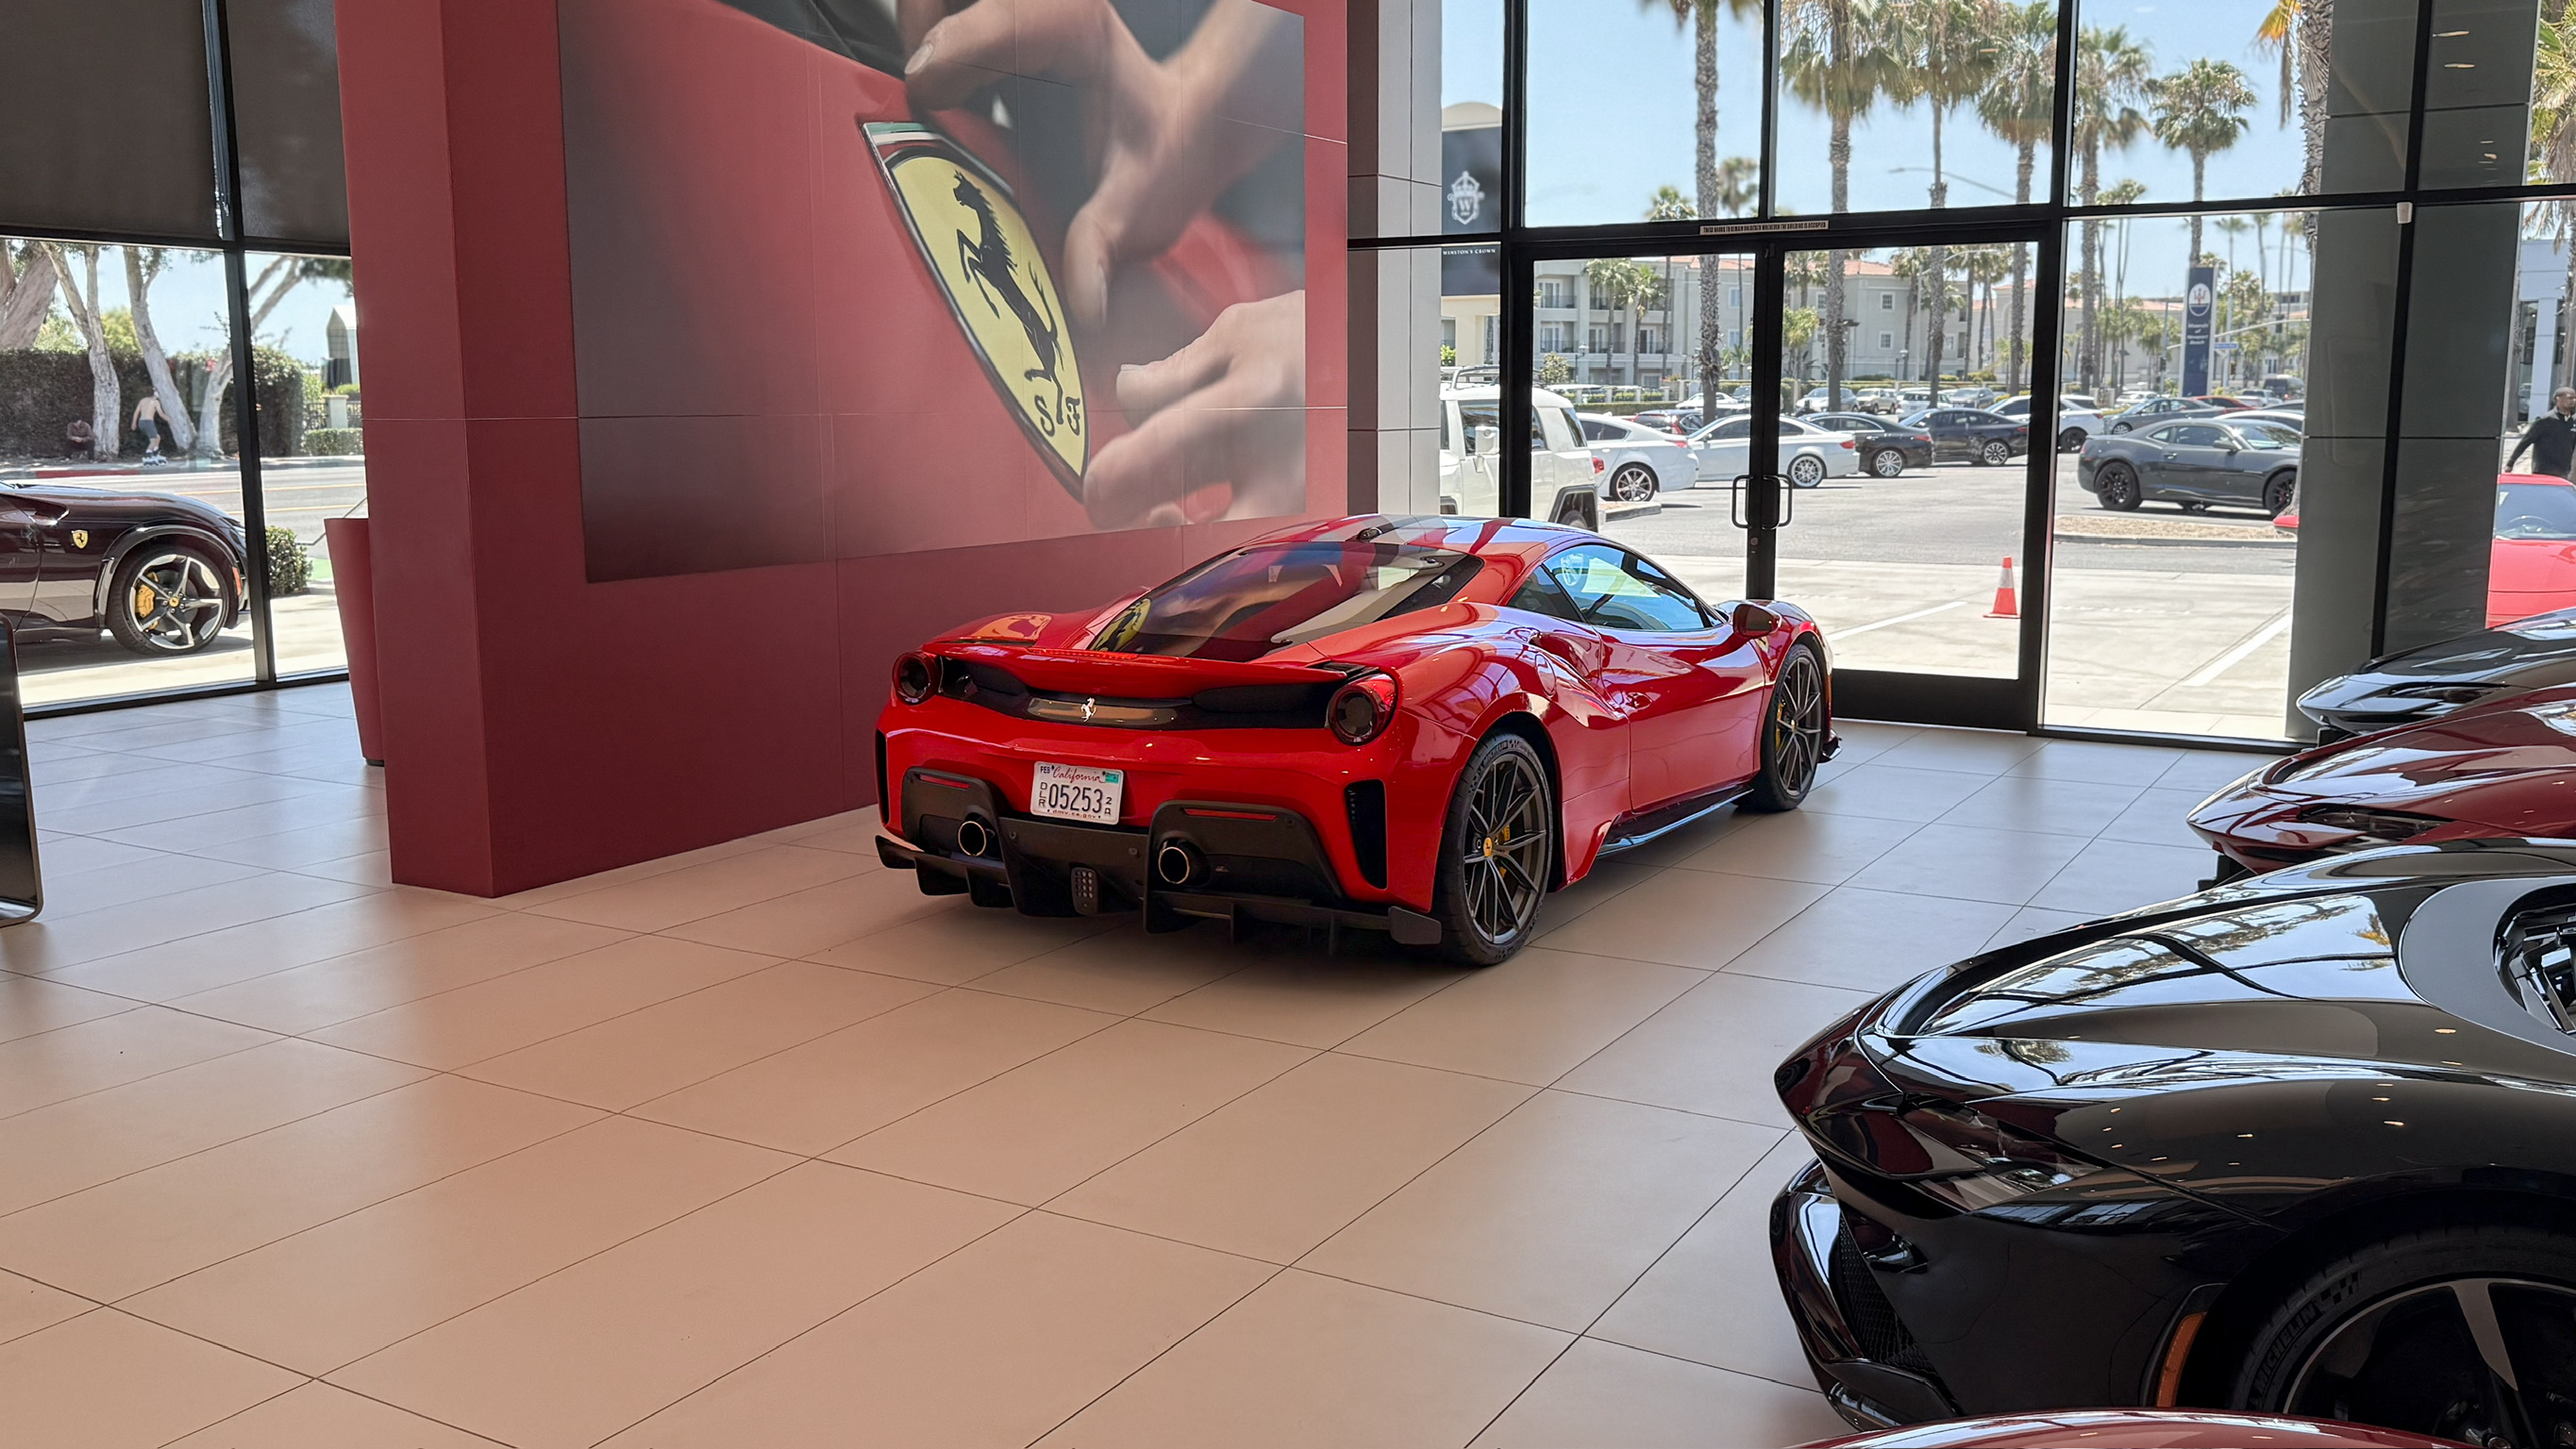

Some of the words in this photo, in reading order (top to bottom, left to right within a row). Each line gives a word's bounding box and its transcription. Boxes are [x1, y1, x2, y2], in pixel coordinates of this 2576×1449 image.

[1034, 394, 1055, 437] S
[1040, 765, 1050, 774] FEB
[1053, 766, 1106, 783] California
[1048, 783, 1103, 813] 05253
[1052, 809, 1096, 818] dmv.ca.gov
